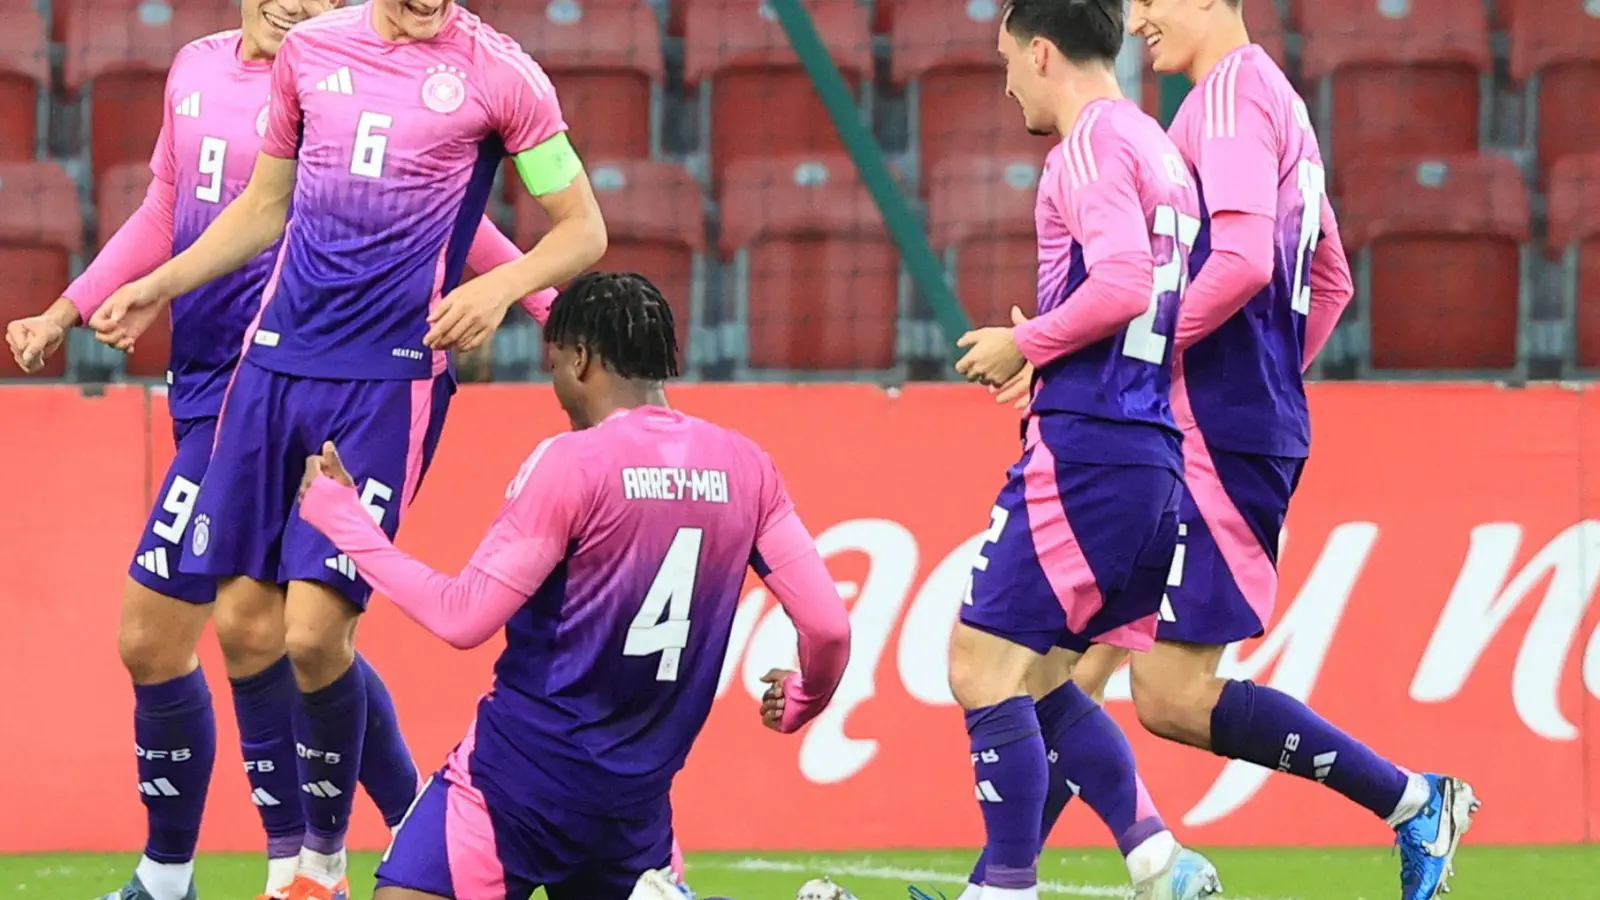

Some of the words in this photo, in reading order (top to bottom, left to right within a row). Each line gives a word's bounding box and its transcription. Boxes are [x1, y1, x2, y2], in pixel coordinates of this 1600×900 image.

[196, 136, 228, 204] 9
[351, 111, 393, 179] 6
[152, 475, 200, 544] 9
[621, 467, 729, 504] ARREY-MBI
[622, 527, 703, 682] 4
